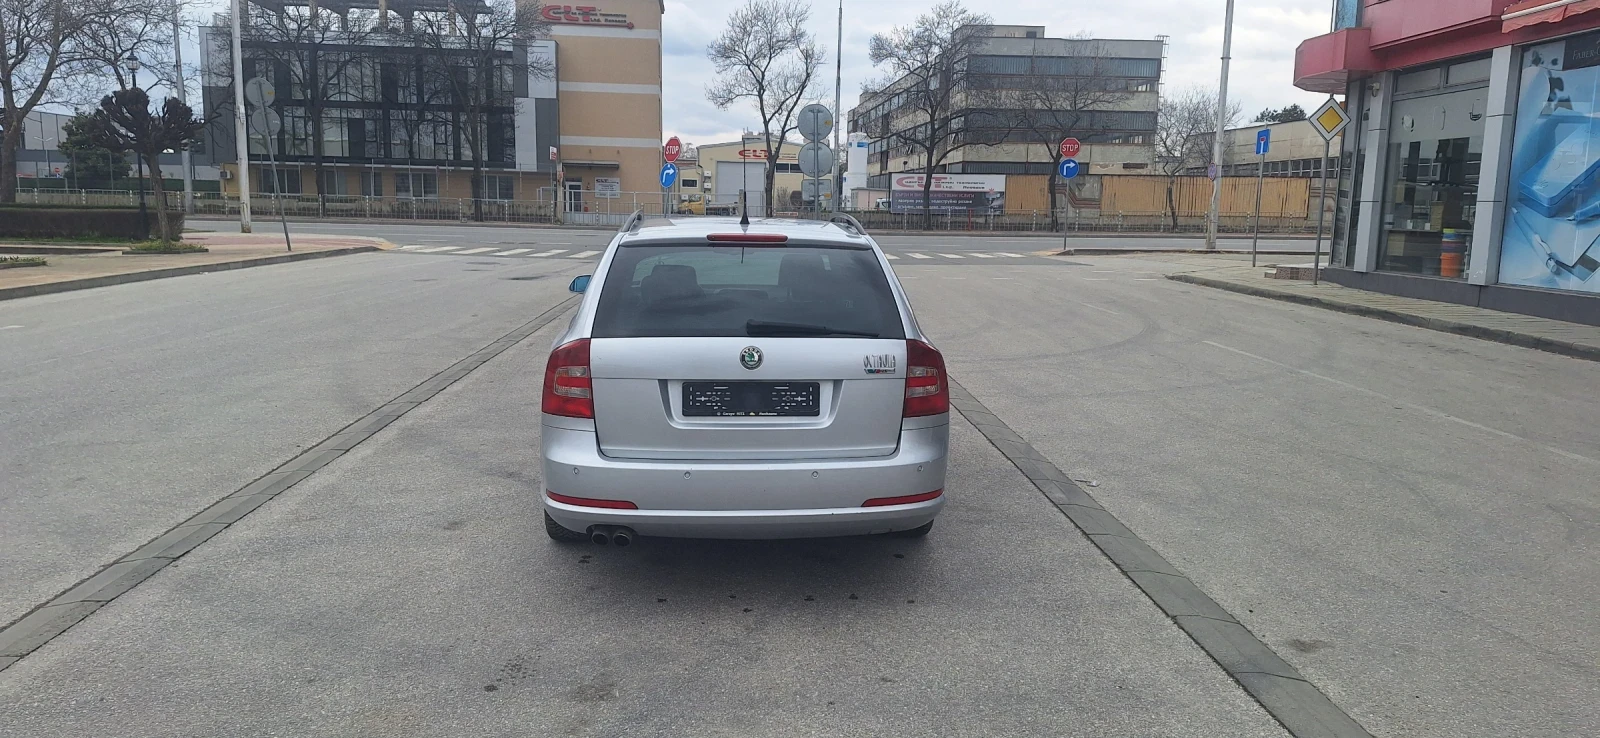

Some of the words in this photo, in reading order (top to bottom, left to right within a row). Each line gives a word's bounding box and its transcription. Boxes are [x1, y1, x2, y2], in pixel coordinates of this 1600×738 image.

[541, 5, 596, 22] CLT
[665, 145, 680, 155] STOP
[1061, 144, 1079, 152] STOP
